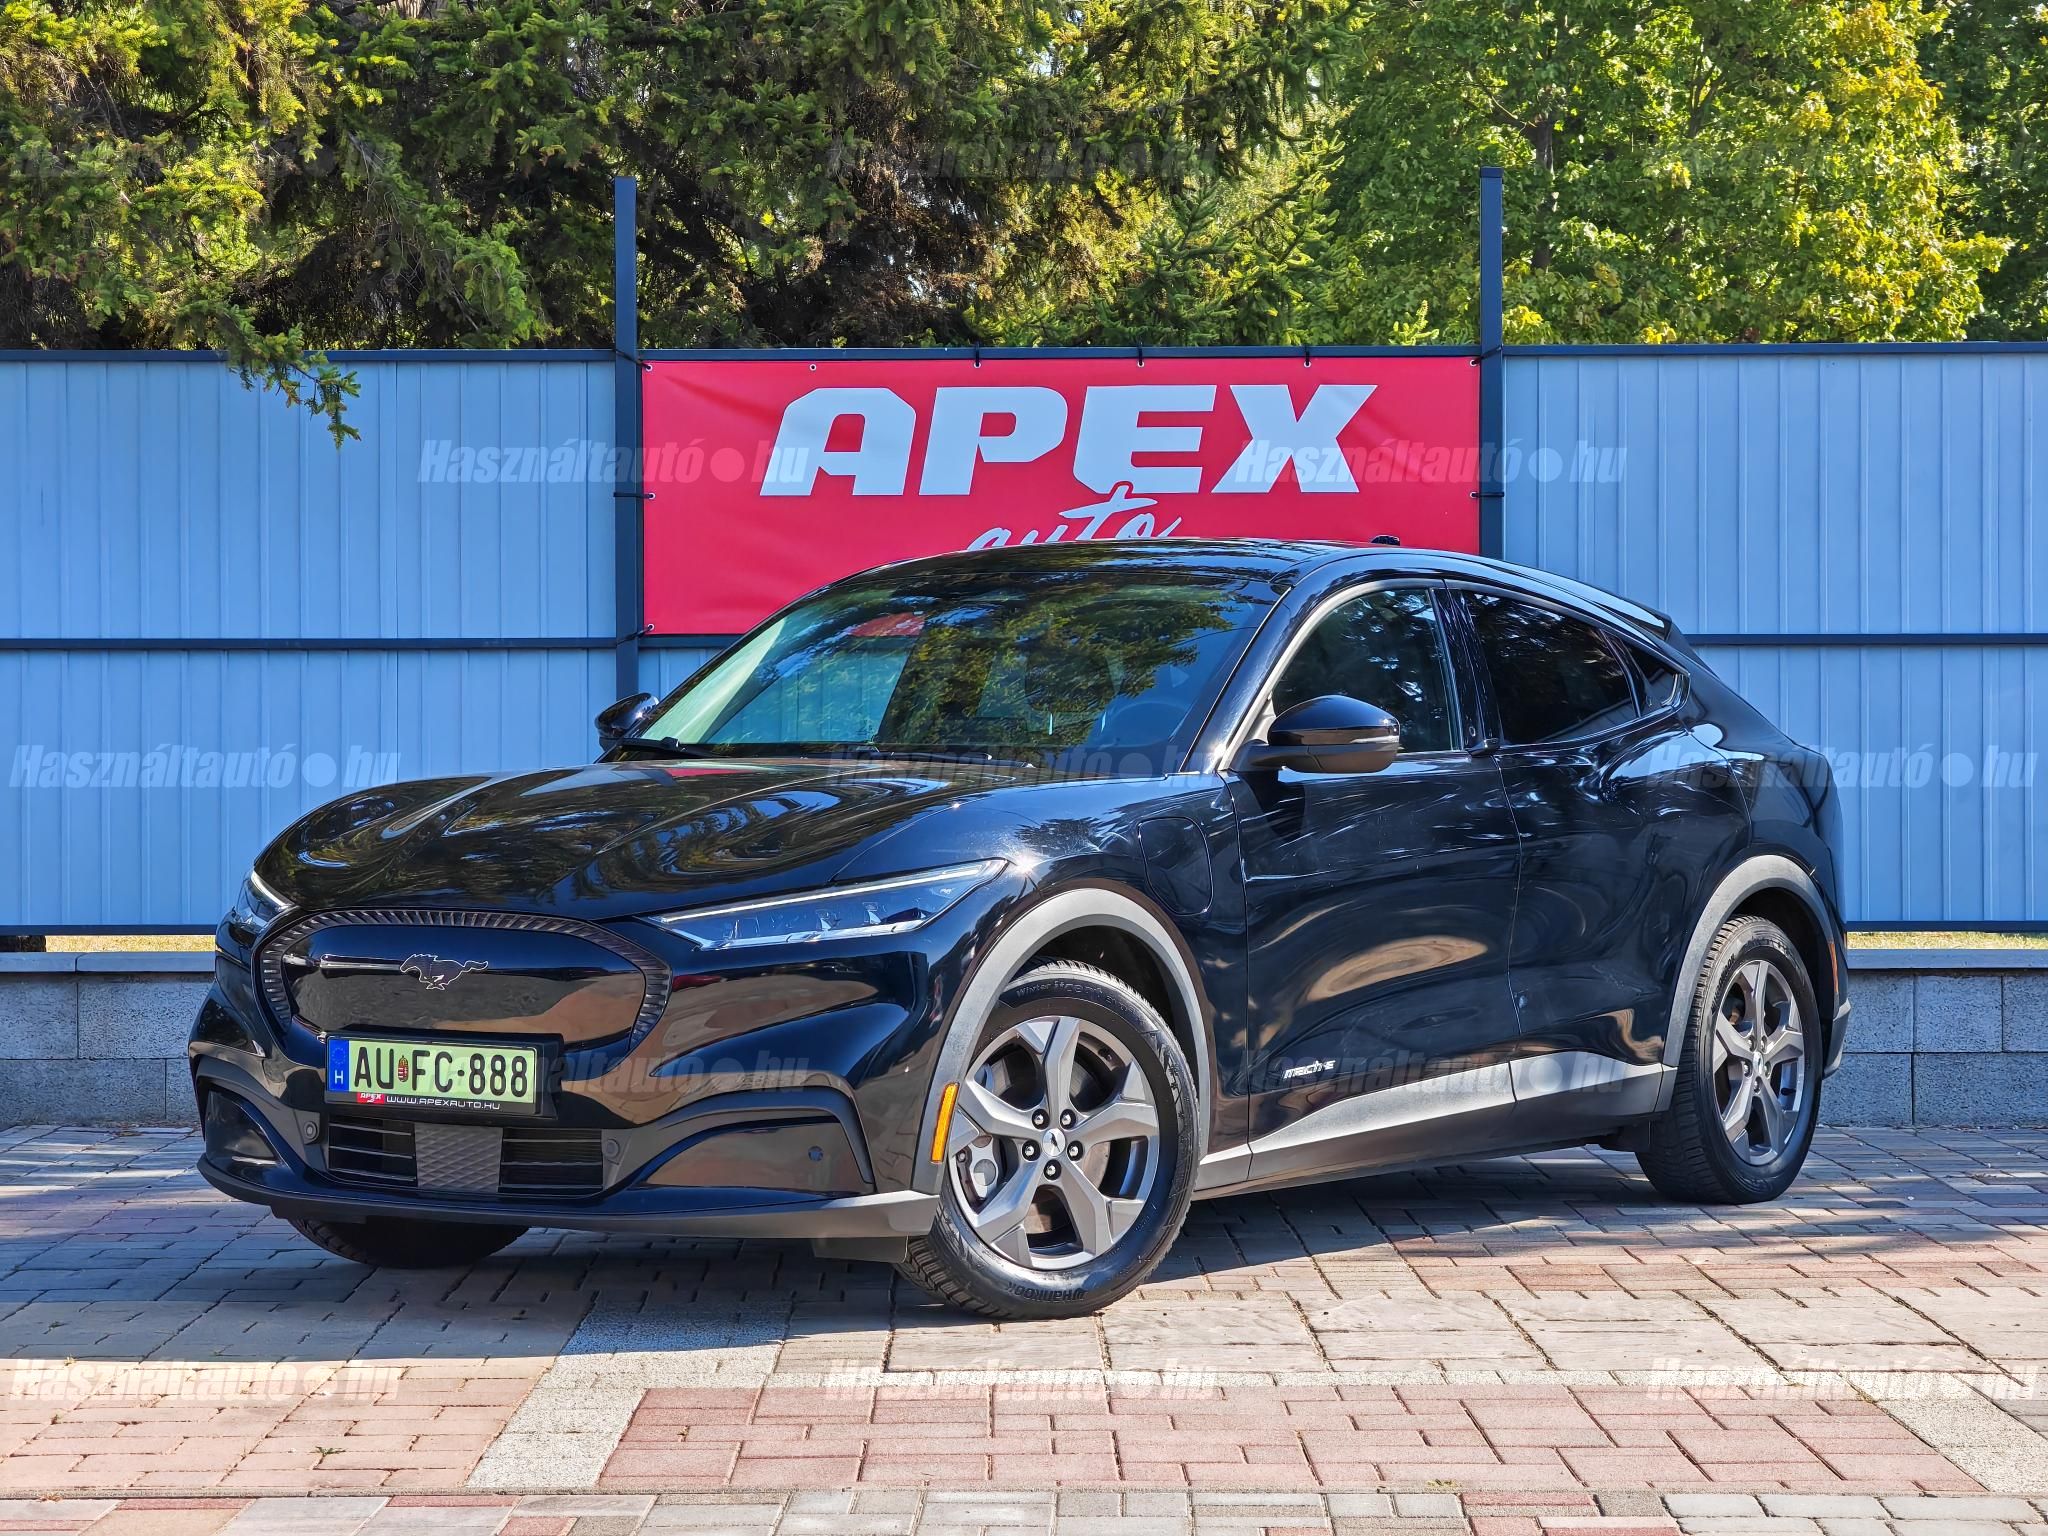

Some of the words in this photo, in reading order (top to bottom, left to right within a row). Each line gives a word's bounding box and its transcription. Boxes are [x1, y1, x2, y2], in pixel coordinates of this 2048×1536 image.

[760, 384, 1378, 497] APEX
[334, 1069, 344, 1085] H
[354, 1046, 394, 1090] AU
[386, 1095, 501, 1110] WWW.APEXAUTO.HU
